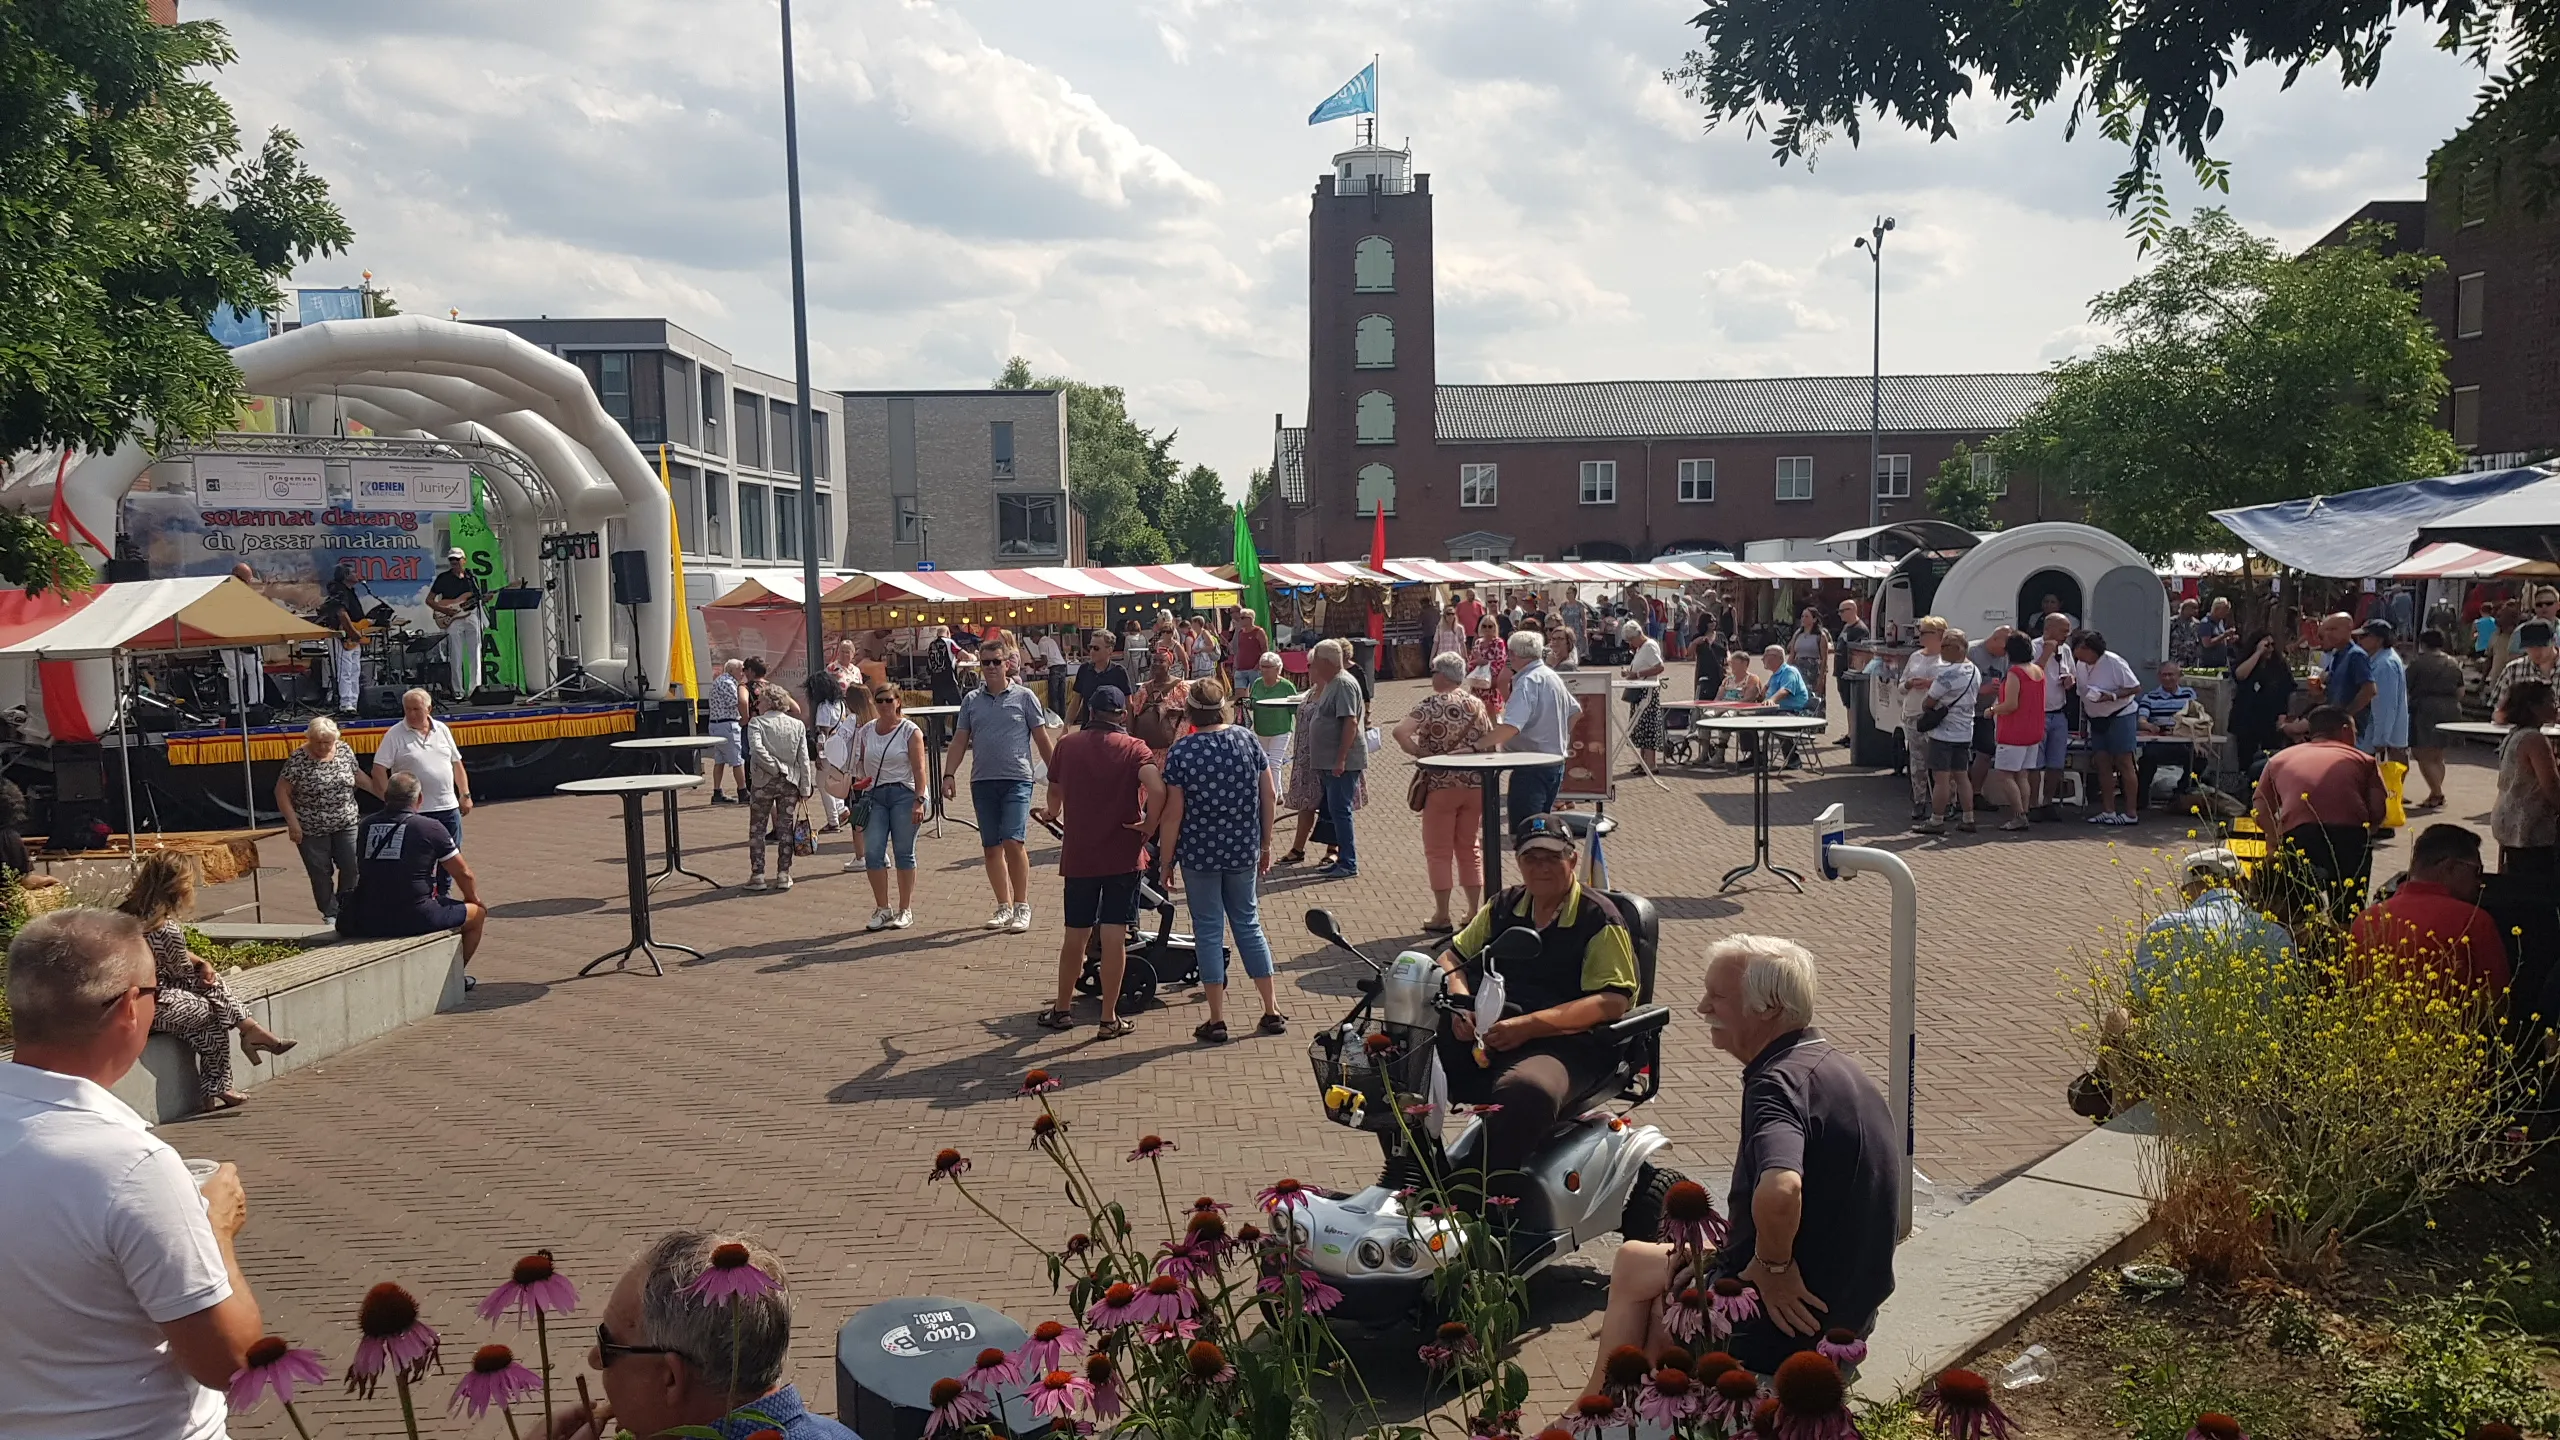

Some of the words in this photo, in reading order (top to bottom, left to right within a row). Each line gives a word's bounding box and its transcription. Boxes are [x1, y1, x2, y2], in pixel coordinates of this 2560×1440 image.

[321, 506, 419, 531] datang
[239, 533, 315, 555] pasar
[320, 532, 420, 549] malam
[913, 1311, 953, 1324] BACO!
[924, 1322, 976, 1342] Ciao
